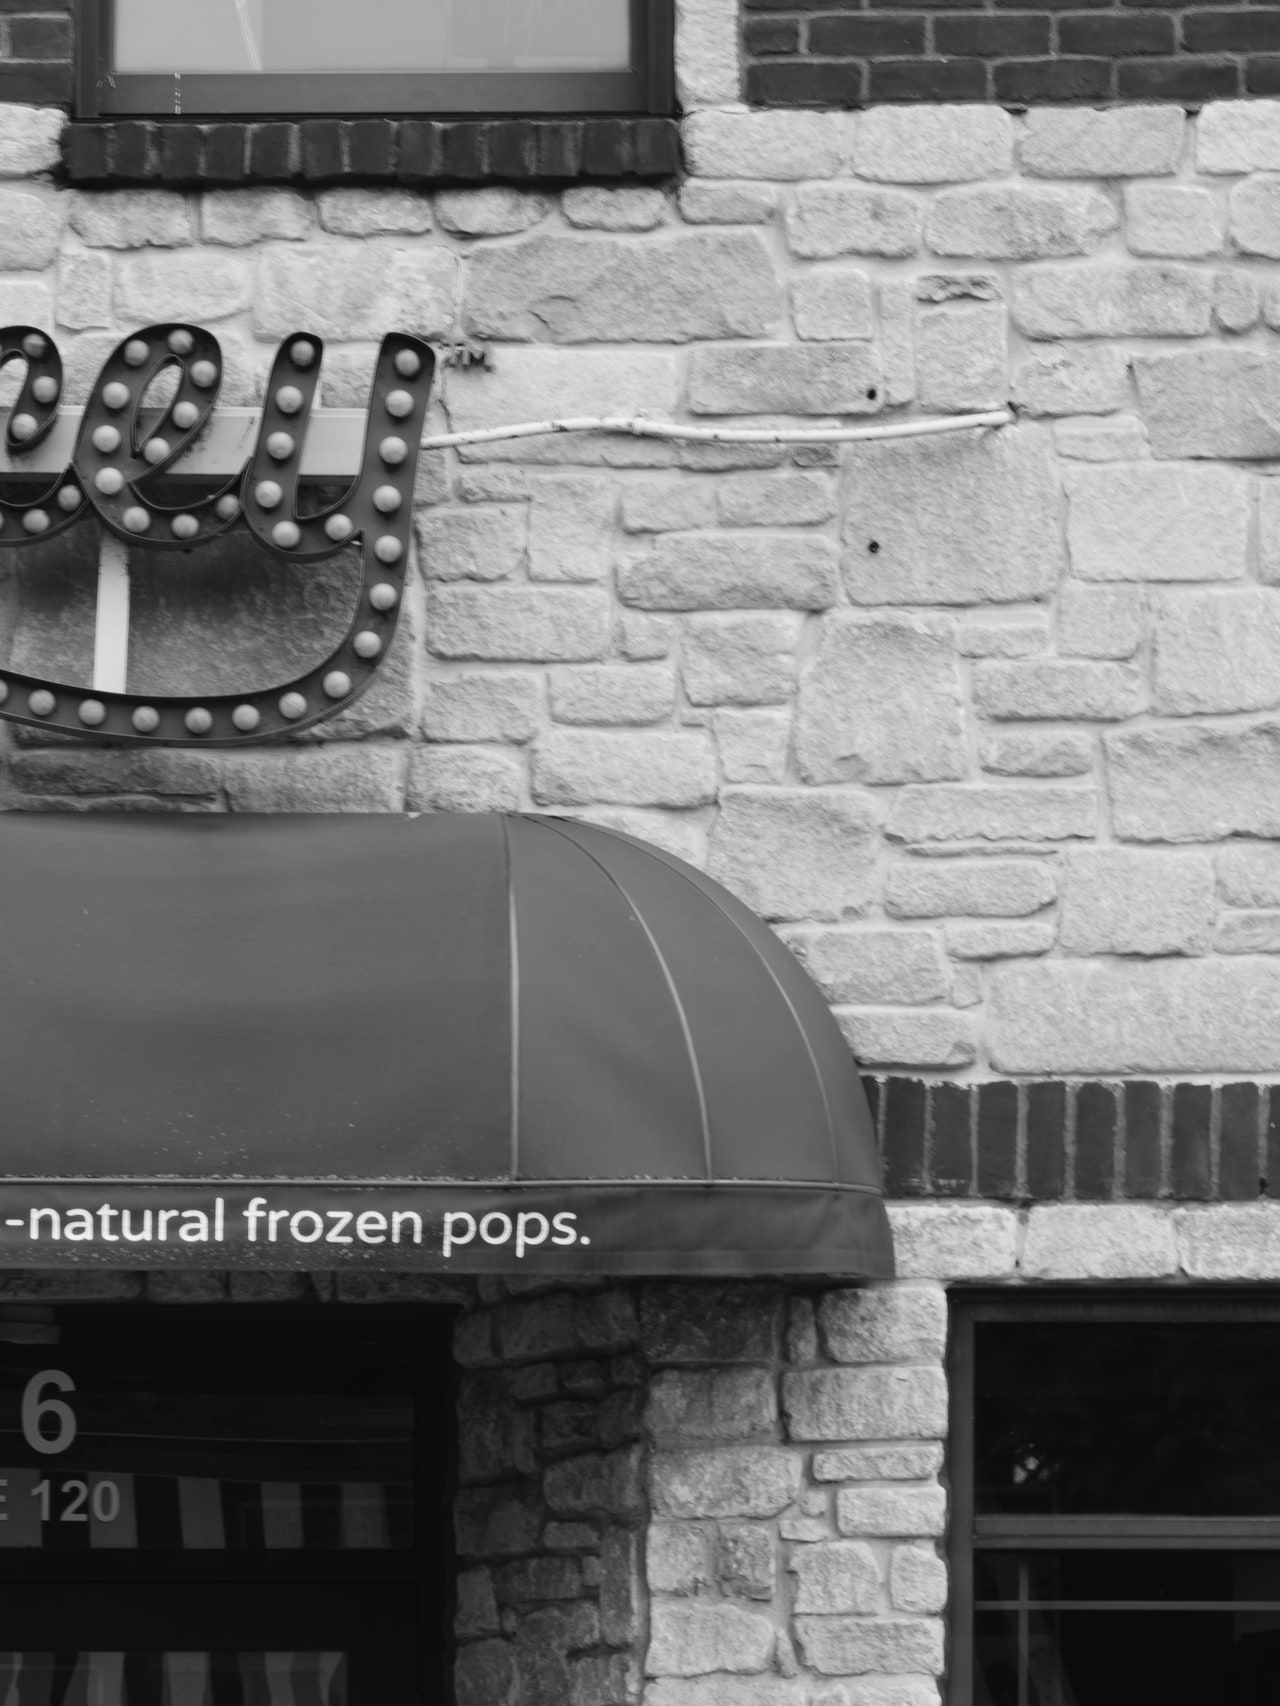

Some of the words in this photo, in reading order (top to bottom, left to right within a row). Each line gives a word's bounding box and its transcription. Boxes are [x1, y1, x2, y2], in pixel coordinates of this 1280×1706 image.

[242, 1197, 422, 1243] frozen
[443, 1209, 592, 1258] pops.
[30, 1478, 121, 1523] 120
